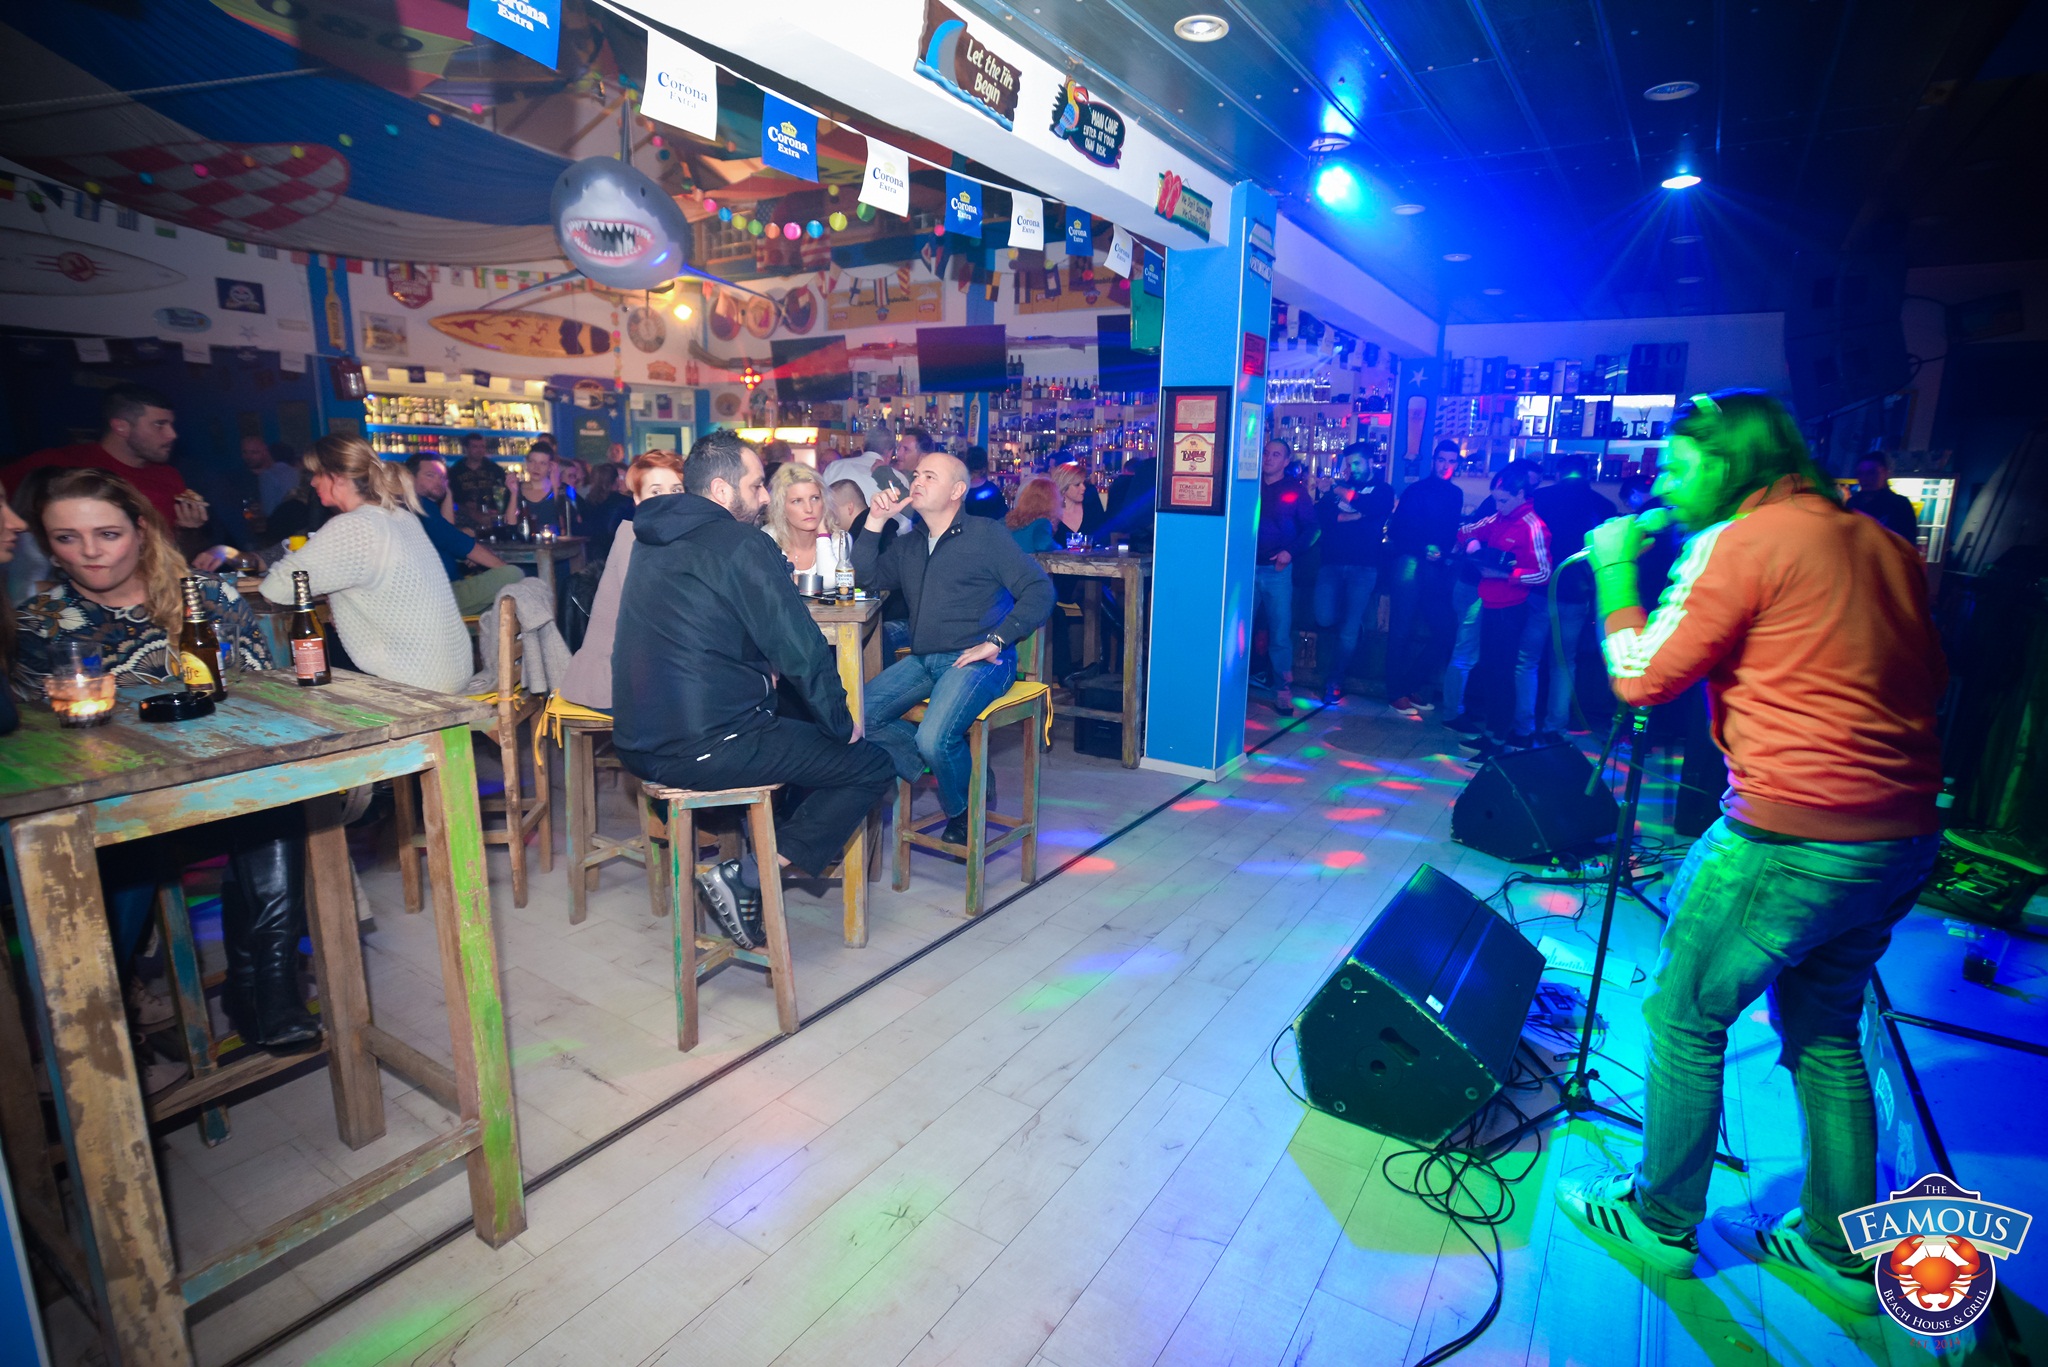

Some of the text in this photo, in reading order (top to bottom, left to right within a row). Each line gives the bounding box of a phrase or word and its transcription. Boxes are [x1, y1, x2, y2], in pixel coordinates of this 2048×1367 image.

[490, 0, 550, 29] rona
[497, 3, 534, 32] Extra
[967, 39, 984, 68] Let
[985, 55, 1001, 80] the
[657, 71, 708, 103] Corona
[974, 72, 1001, 105] Begin
[669, 90, 698, 109] Extra
[1091, 109, 1119, 136] MAN CAVE
[767, 126, 810, 155] Corona
[1083, 124, 1115, 149] ENTER AT YOUR
[777, 143, 800, 159] Extra
[1084, 137, 1107, 158] OWN RISK
[872, 167, 905, 189] Corona
[879, 181, 897, 194] Extra
[950, 197, 978, 215] Corona
[957, 209, 972, 221] Extra
[1016, 215, 1041, 228] Corona
[1021, 226, 1035, 235] Extra
[1068, 226, 1088, 238] Corona
[1114, 242, 1131, 259] Corona
